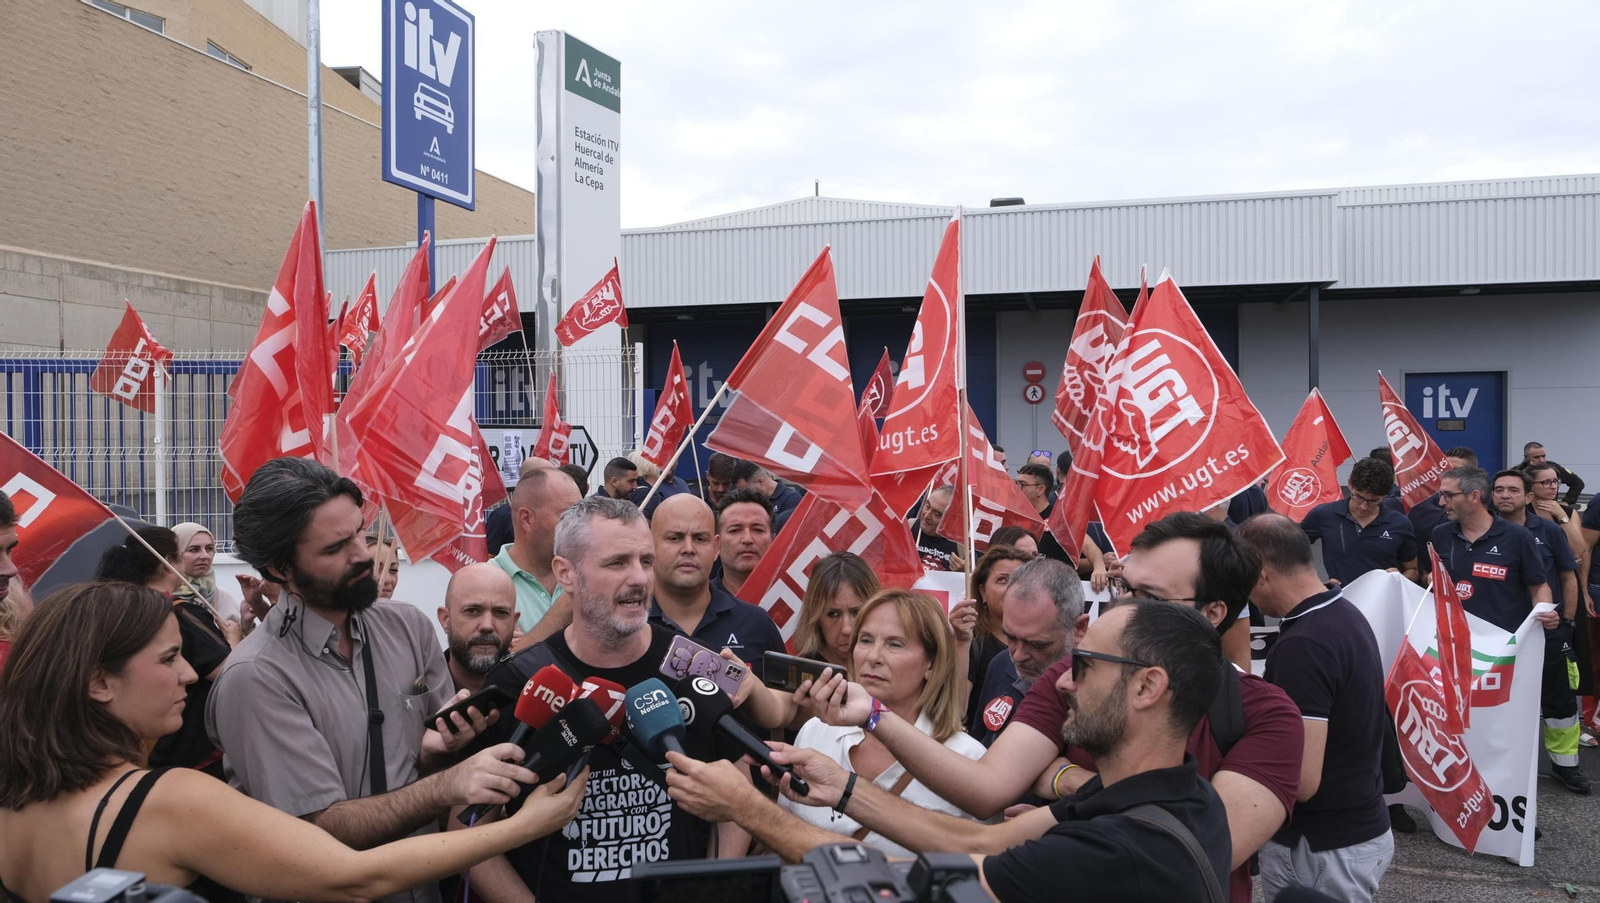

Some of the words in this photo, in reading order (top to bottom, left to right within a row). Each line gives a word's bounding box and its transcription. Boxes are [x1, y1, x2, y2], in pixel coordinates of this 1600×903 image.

[404, 1, 461, 87] itv
[594, 68, 611, 82] Junta
[594, 78, 602, 88] de
[575, 126, 606, 147] Estación
[608, 139, 619, 152] ITV
[575, 141, 603, 161] Huercal
[605, 153, 614, 164] de
[432, 169, 448, 184] 0411
[574, 157, 603, 175] Almería
[575, 172, 584, 184] La
[585, 176, 604, 191] Cepa
[1119, 338, 1205, 446] UGT
[1423, 383, 1478, 418] itv
[1310, 440, 1330, 467] Andal
[1126, 442, 1250, 524] www.ugt.es
[1281, 472, 1308, 500] UGT
[1474, 564, 1506, 576] CCOO
[1456, 583, 1472, 593] UGT
[534, 684, 566, 713] rne
[640, 699, 670, 716] Noticias
[585, 773, 641, 796] SECTOR
[589, 770, 601, 779] or
[603, 768, 616, 777] un
[583, 788, 656, 812] AGRARIO
[631, 806, 648, 814] con
[582, 812, 661, 842] FUTURO
[568, 838, 669, 870] DERECHOS
[580, 841, 587, 850] y
